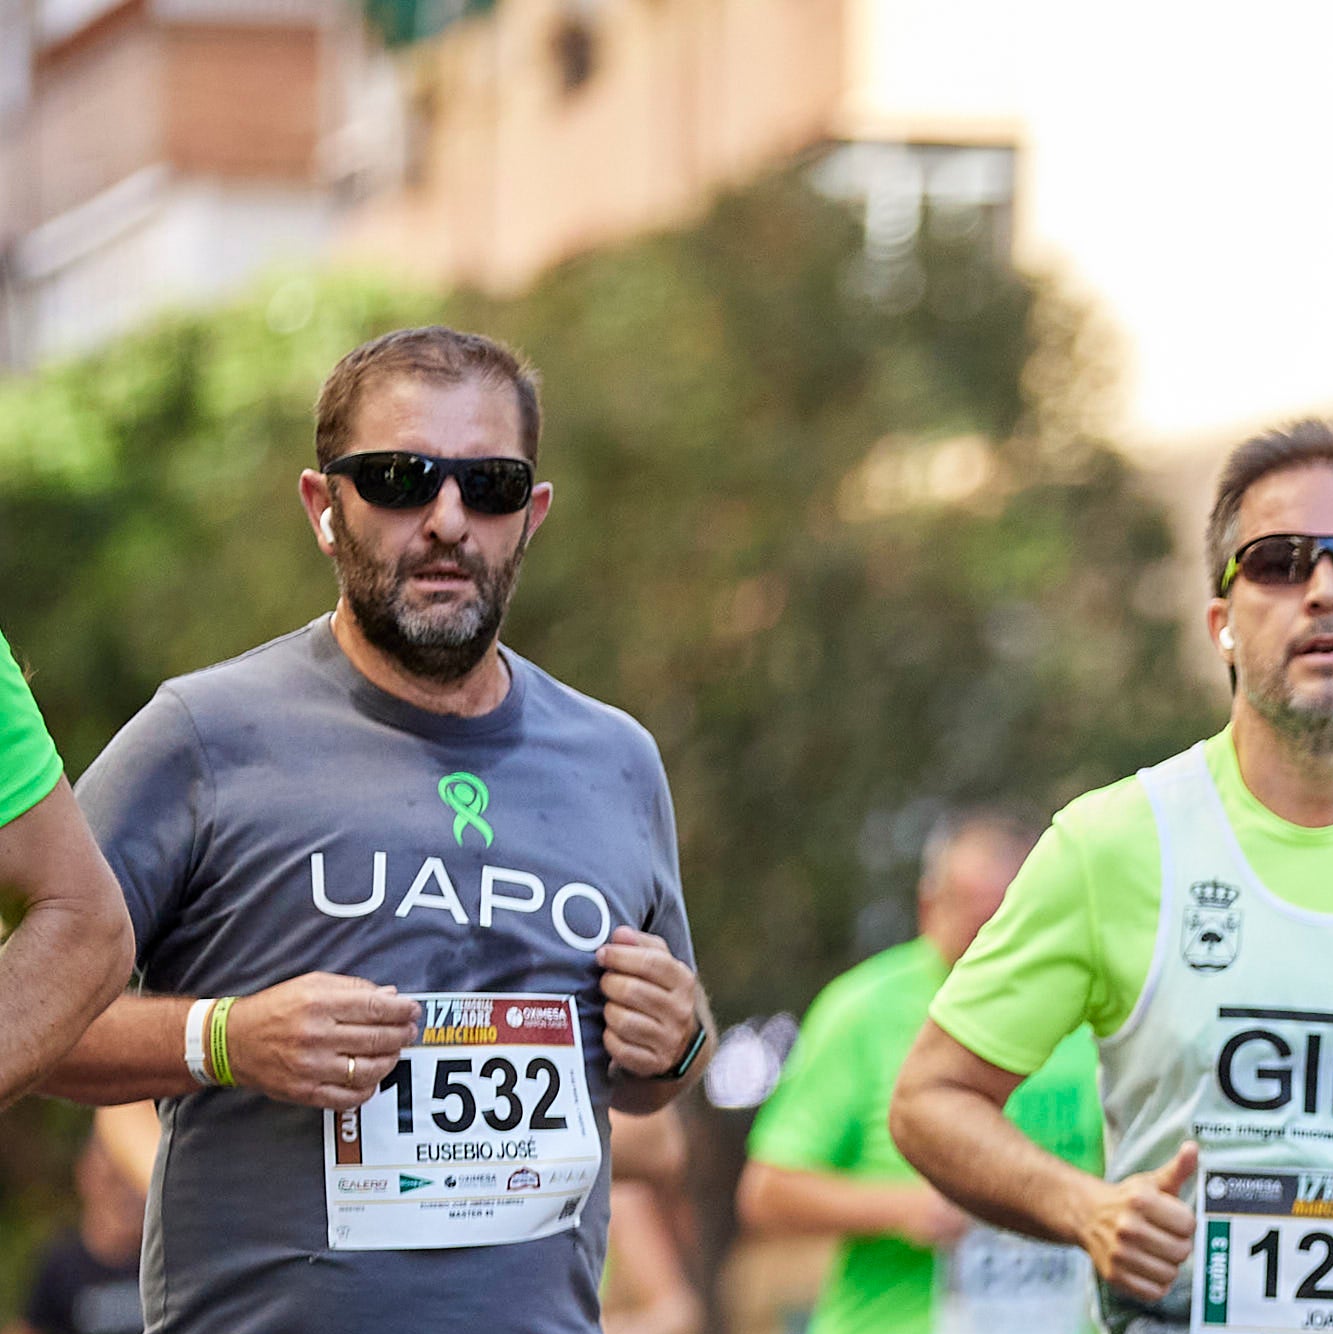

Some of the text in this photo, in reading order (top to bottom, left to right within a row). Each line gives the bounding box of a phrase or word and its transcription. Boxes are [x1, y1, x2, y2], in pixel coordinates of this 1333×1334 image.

[311, 851, 611, 953] UAPO
[426, 1000, 453, 1029] 17
[452, 1008, 491, 1028] PADRE
[522, 1006, 568, 1020] OXIMESA
[422, 1025, 498, 1045] MARCELINO
[379, 1057, 568, 1135] 1532
[416, 1136, 538, 1163] EUSEBIO JOSÉ
